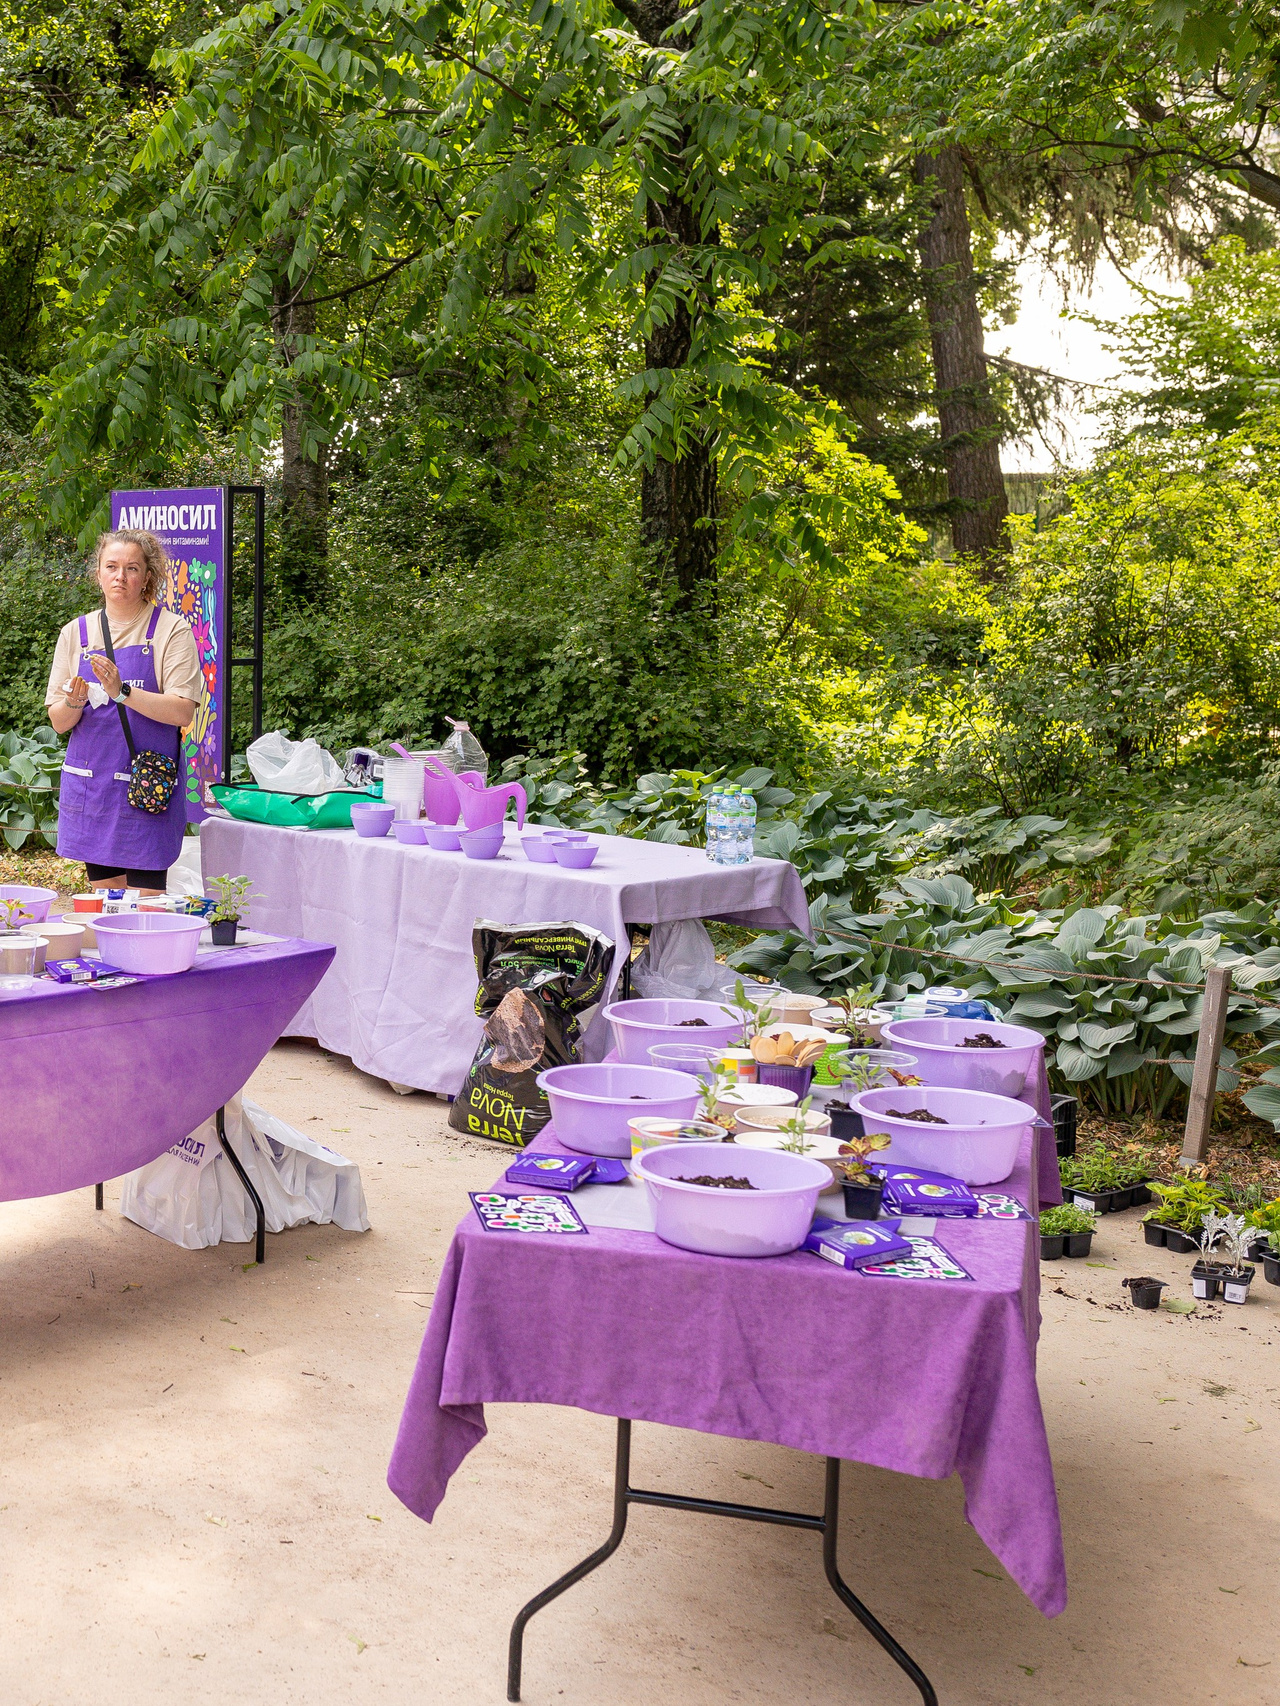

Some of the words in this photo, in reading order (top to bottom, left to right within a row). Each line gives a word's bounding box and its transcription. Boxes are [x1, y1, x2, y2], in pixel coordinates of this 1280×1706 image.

[117, 504, 217, 531] АМИНОСИЛ
[535, 944, 555, 953] Nova
[555, 944, 576, 953] Terra
[470, 1087, 526, 1130] Nova
